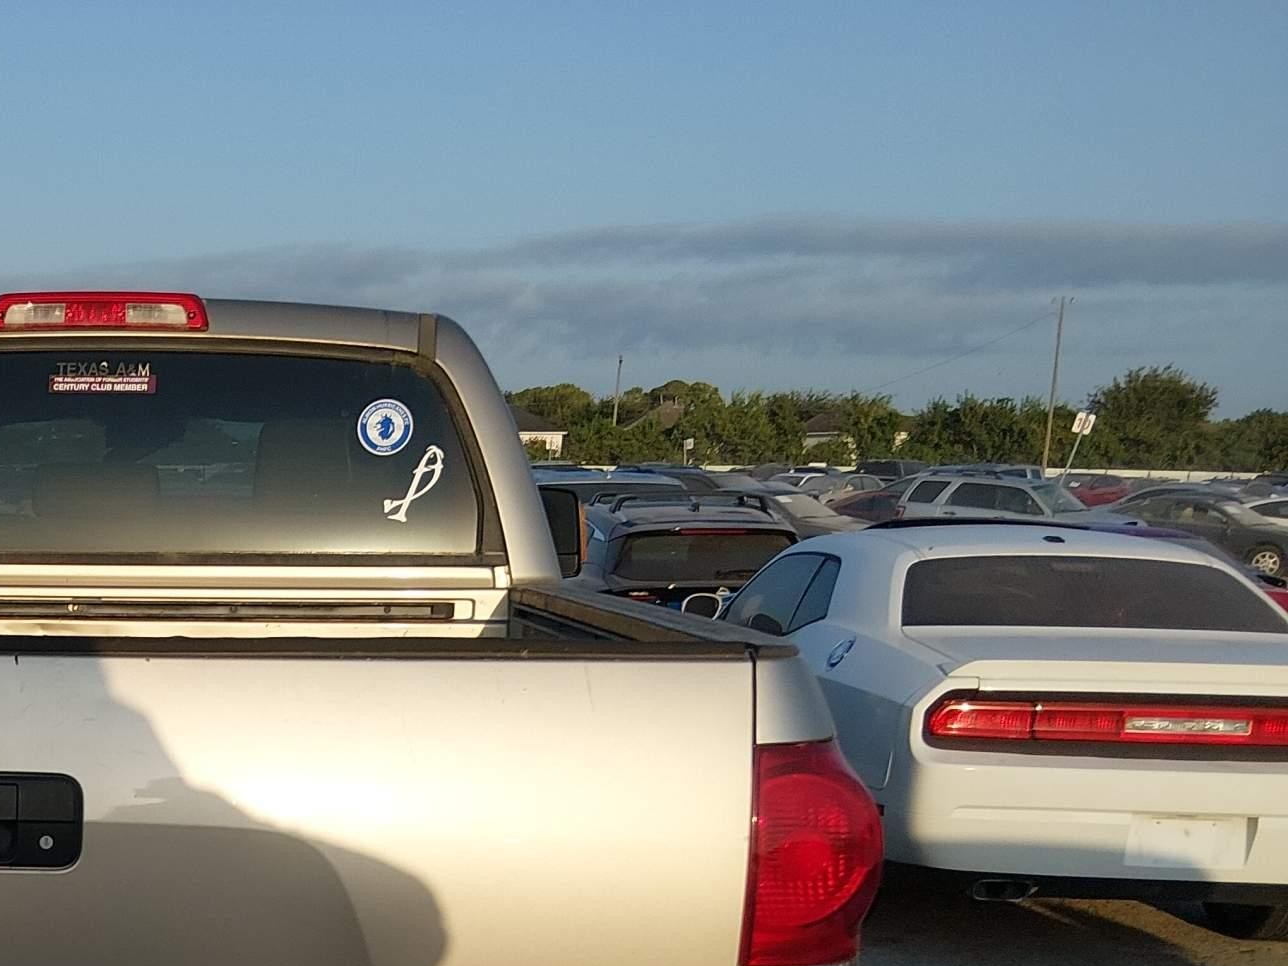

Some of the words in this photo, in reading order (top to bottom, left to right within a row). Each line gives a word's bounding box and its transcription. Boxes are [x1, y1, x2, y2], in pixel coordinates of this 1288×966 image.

[56, 362, 109, 376] TEXAS
[116, 362, 150, 376] A&M
[53, 383, 89, 391] CENTURY
[91, 383, 112, 391] CLUB
[114, 383, 148, 391] MEMBER
